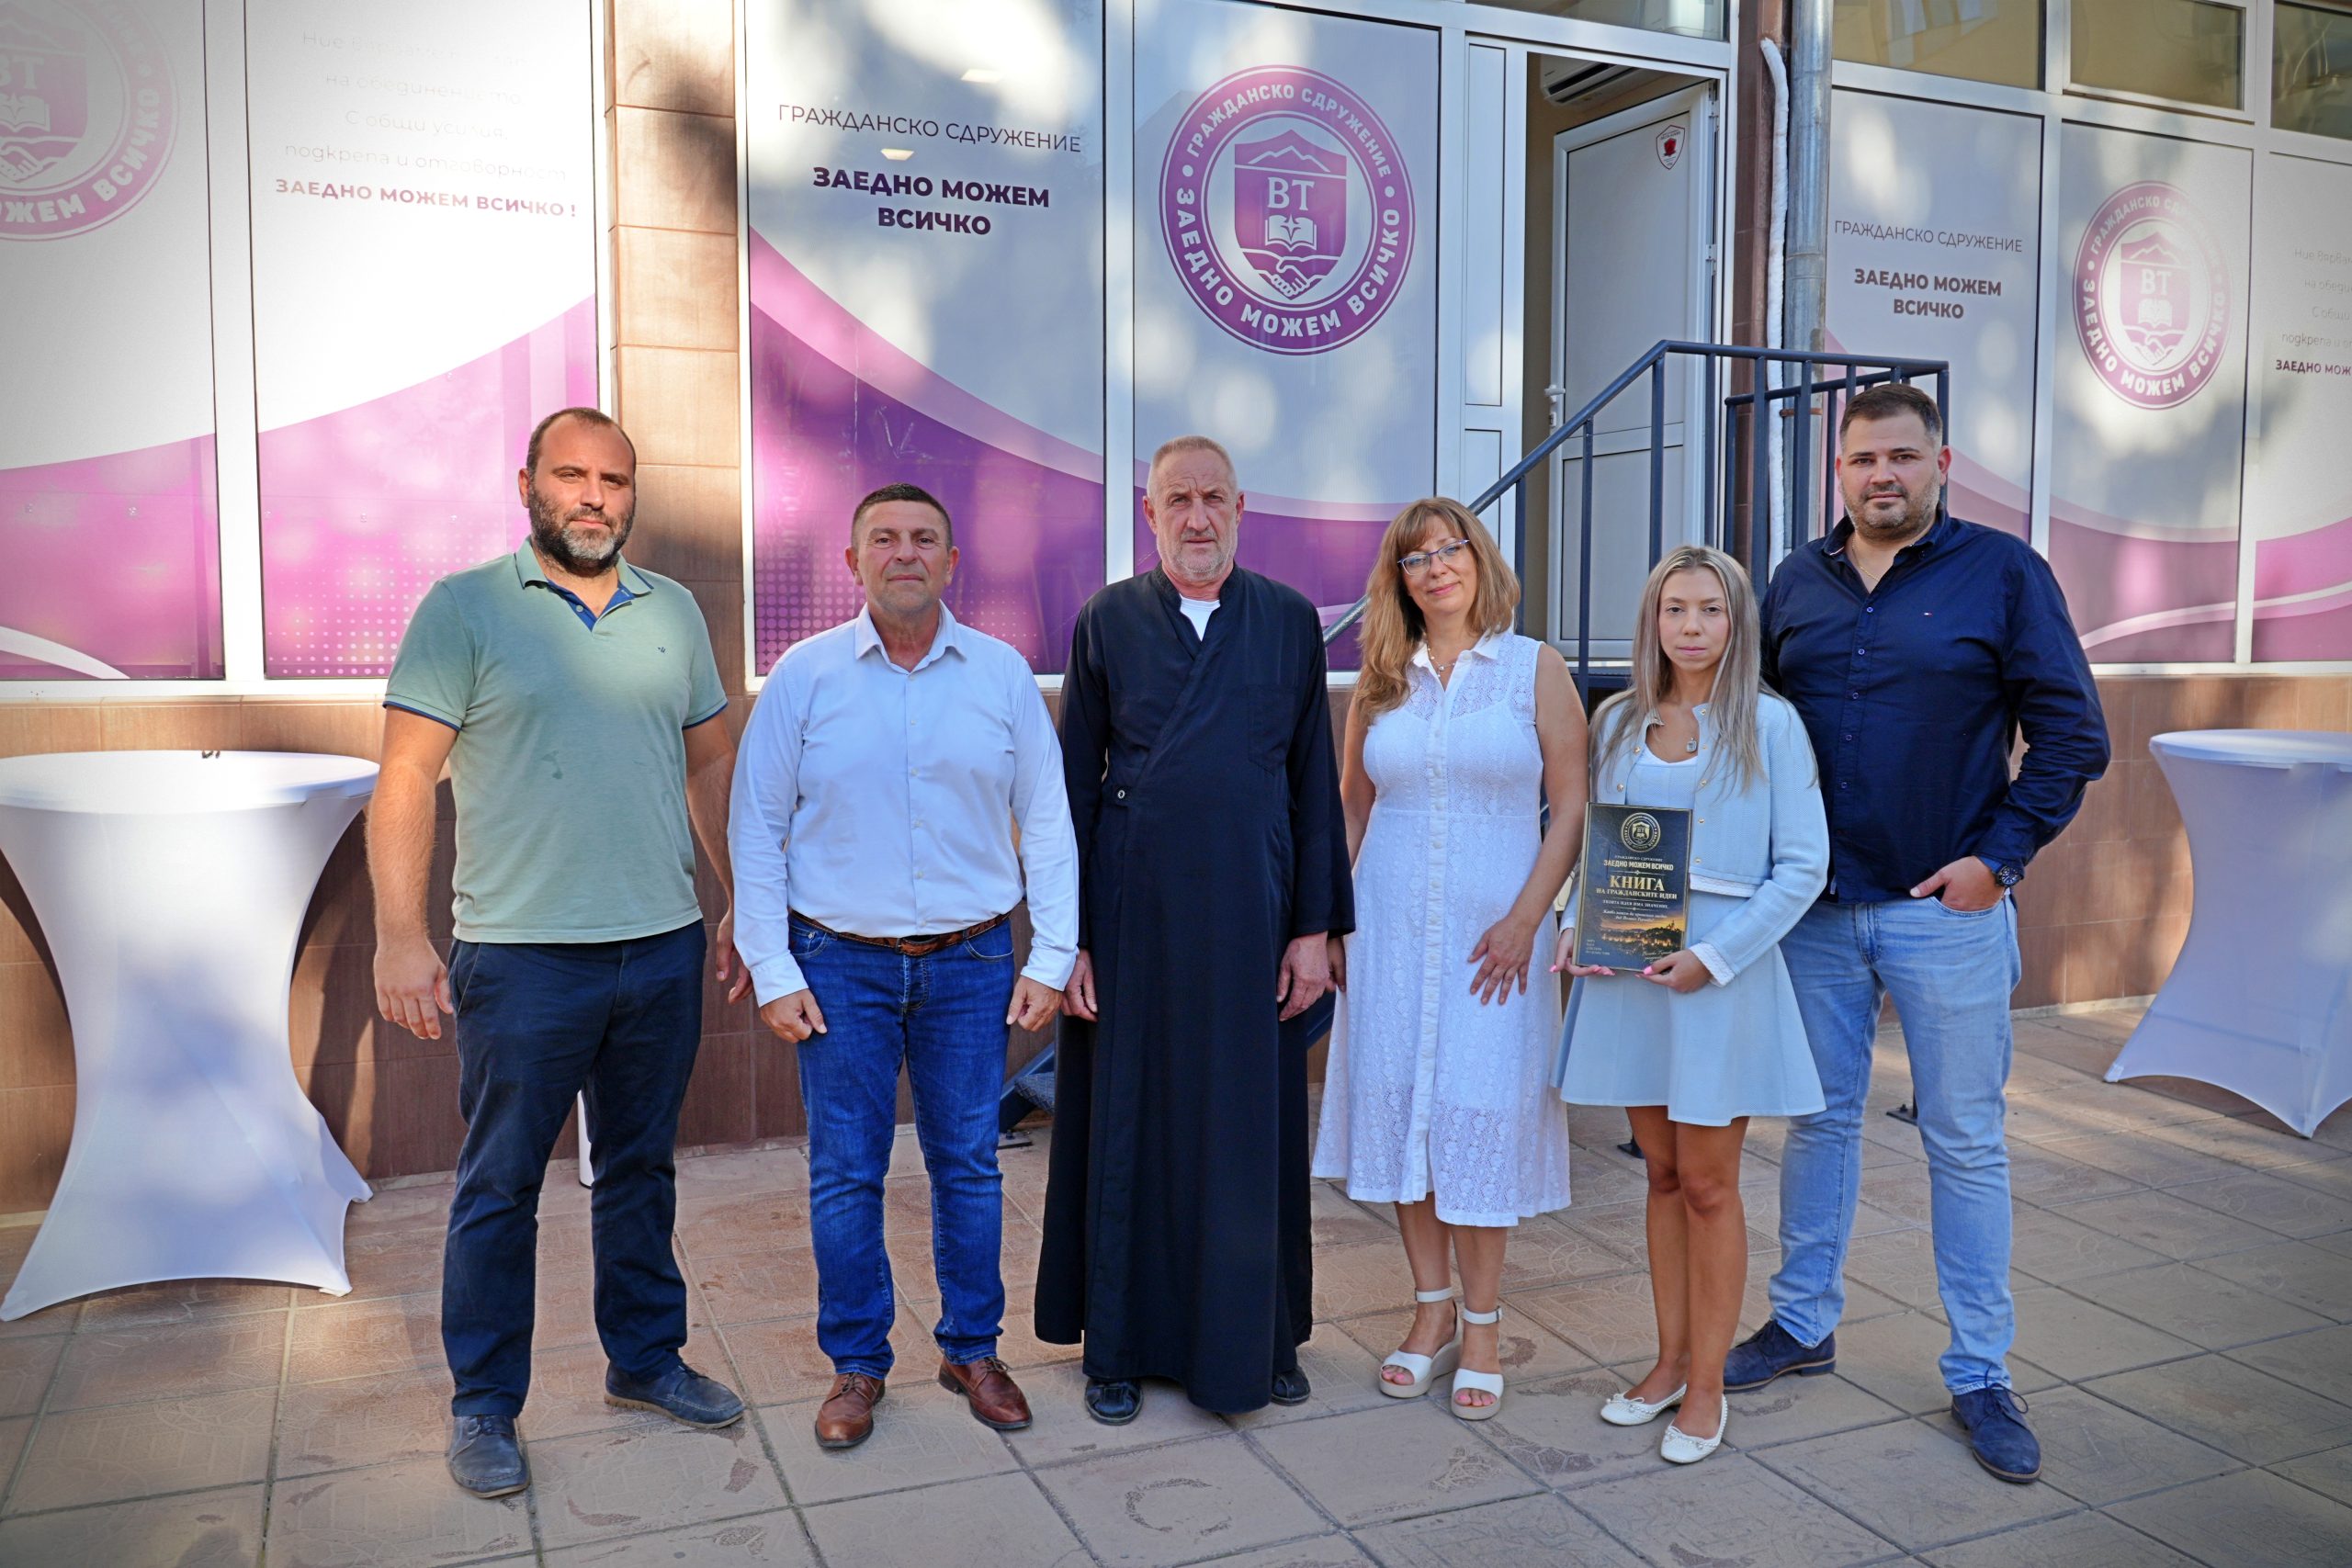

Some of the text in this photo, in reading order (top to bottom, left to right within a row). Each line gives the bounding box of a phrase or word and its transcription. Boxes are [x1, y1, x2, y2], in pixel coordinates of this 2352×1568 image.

[778, 104, 1081, 152] ГРАЖДАНСКО СДРУЖЕНИЕ
[1186, 84, 1391, 178] ГРАЖДАНСКО СДРУЖЕНИЕ
[92, 88, 161, 202] ВСИЧКО
[285, 143, 390, 165] подкрепа
[275, 177, 373, 199] ЗАЕДНО
[379, 186, 469, 208] МОЖЕМ
[476, 196, 564, 217] ВСИЧКО
[812, 166, 1050, 208] ЗАЕДНО МОЖЕМ
[1266, 176, 1315, 211] ВТ
[877, 207, 991, 236] ВСИЧКО
[1834, 220, 2022, 253] ГРАЖДАНСКО СДРУЖЕНИЕ
[2090, 196, 2160, 255] ГРАЖДАНСКО
[1176, 187, 1401, 338] ЗАЕДНО МОЖЕМ ВСИЧКО
[1854, 268, 2002, 297] ЗАЕДНО МОЖЕМ
[2140, 268, 2172, 296] ВТ
[1894, 299, 1964, 319] ВСИЧКО
[2083, 278, 2226, 396] ЗАЕДНО МОЖЕМ ВСИЧКО
[2281, 333, 2332, 347] подкрепа
[2276, 358, 2322, 374] ЗАЕДНО
[1603, 860, 1628, 868] ЗАЕДНО
[1629, 861, 1651, 869] МОЖЕМ
[1610, 874, 1665, 891] КНИГА
